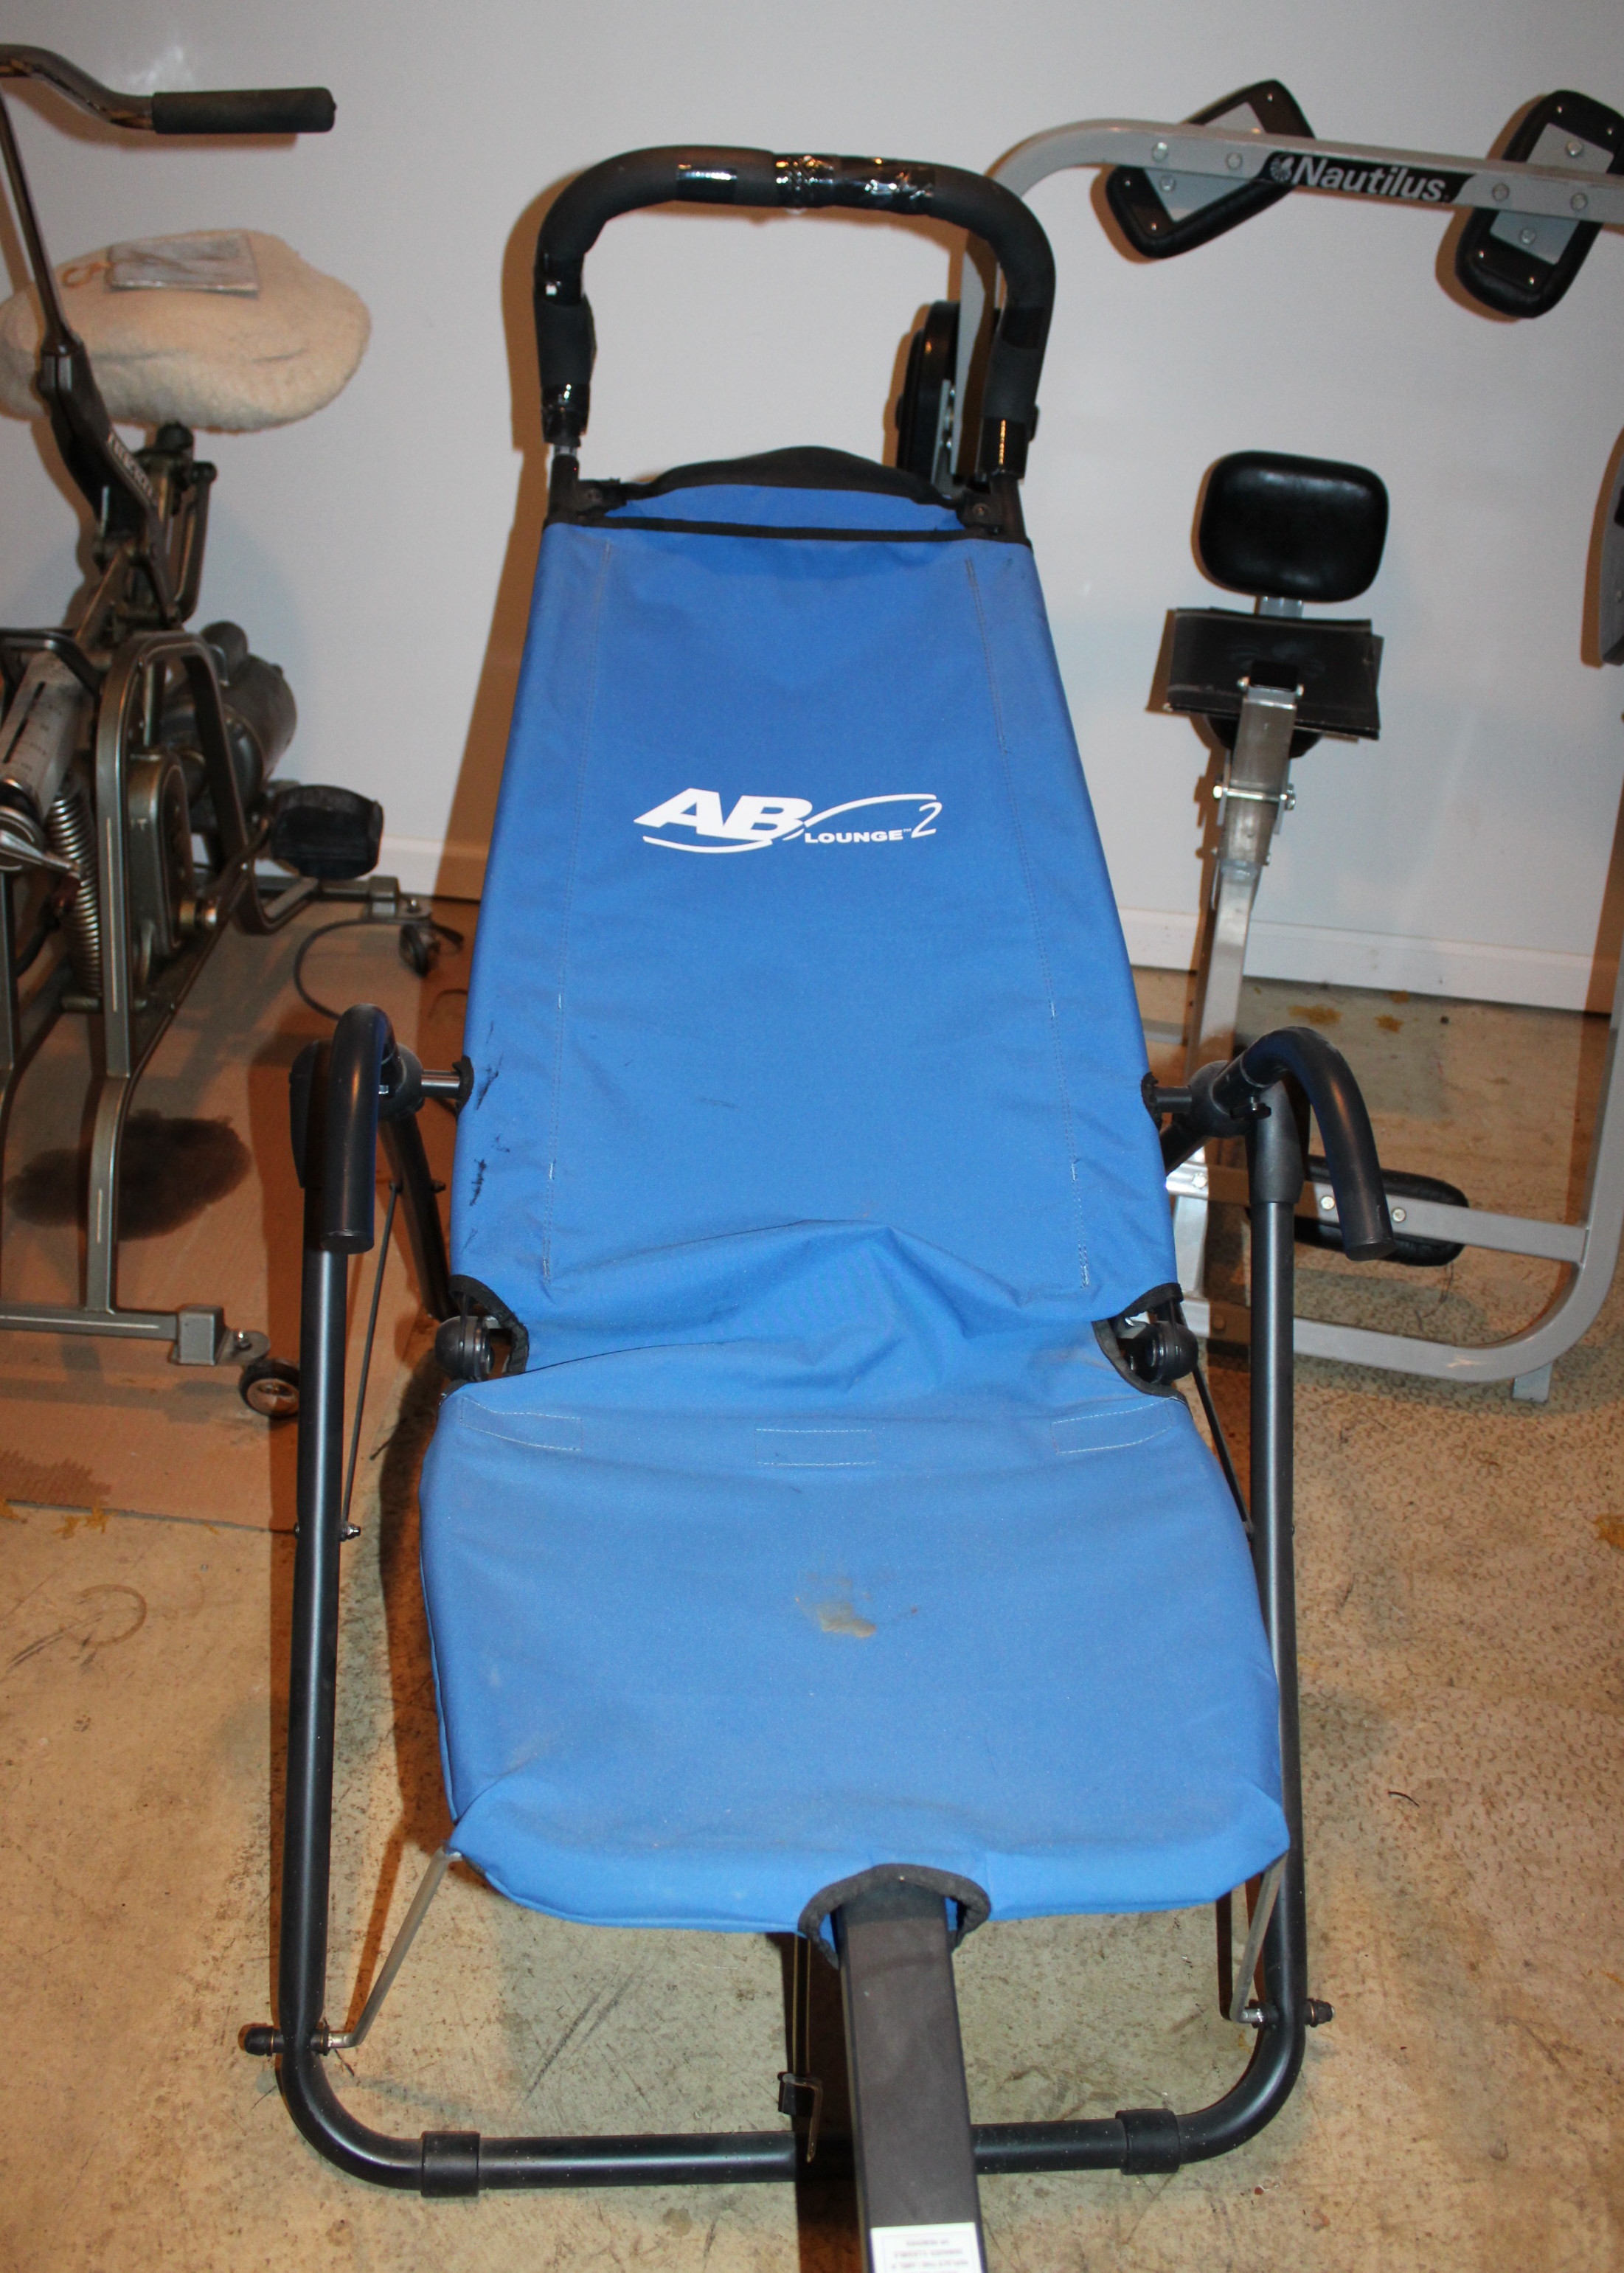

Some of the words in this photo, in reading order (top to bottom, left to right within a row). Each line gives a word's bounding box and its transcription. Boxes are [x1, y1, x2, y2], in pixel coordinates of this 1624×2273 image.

[1292, 155, 1446, 203] Nautilus
[633, 788, 813, 841] AB
[910, 802, 943, 839] 2
